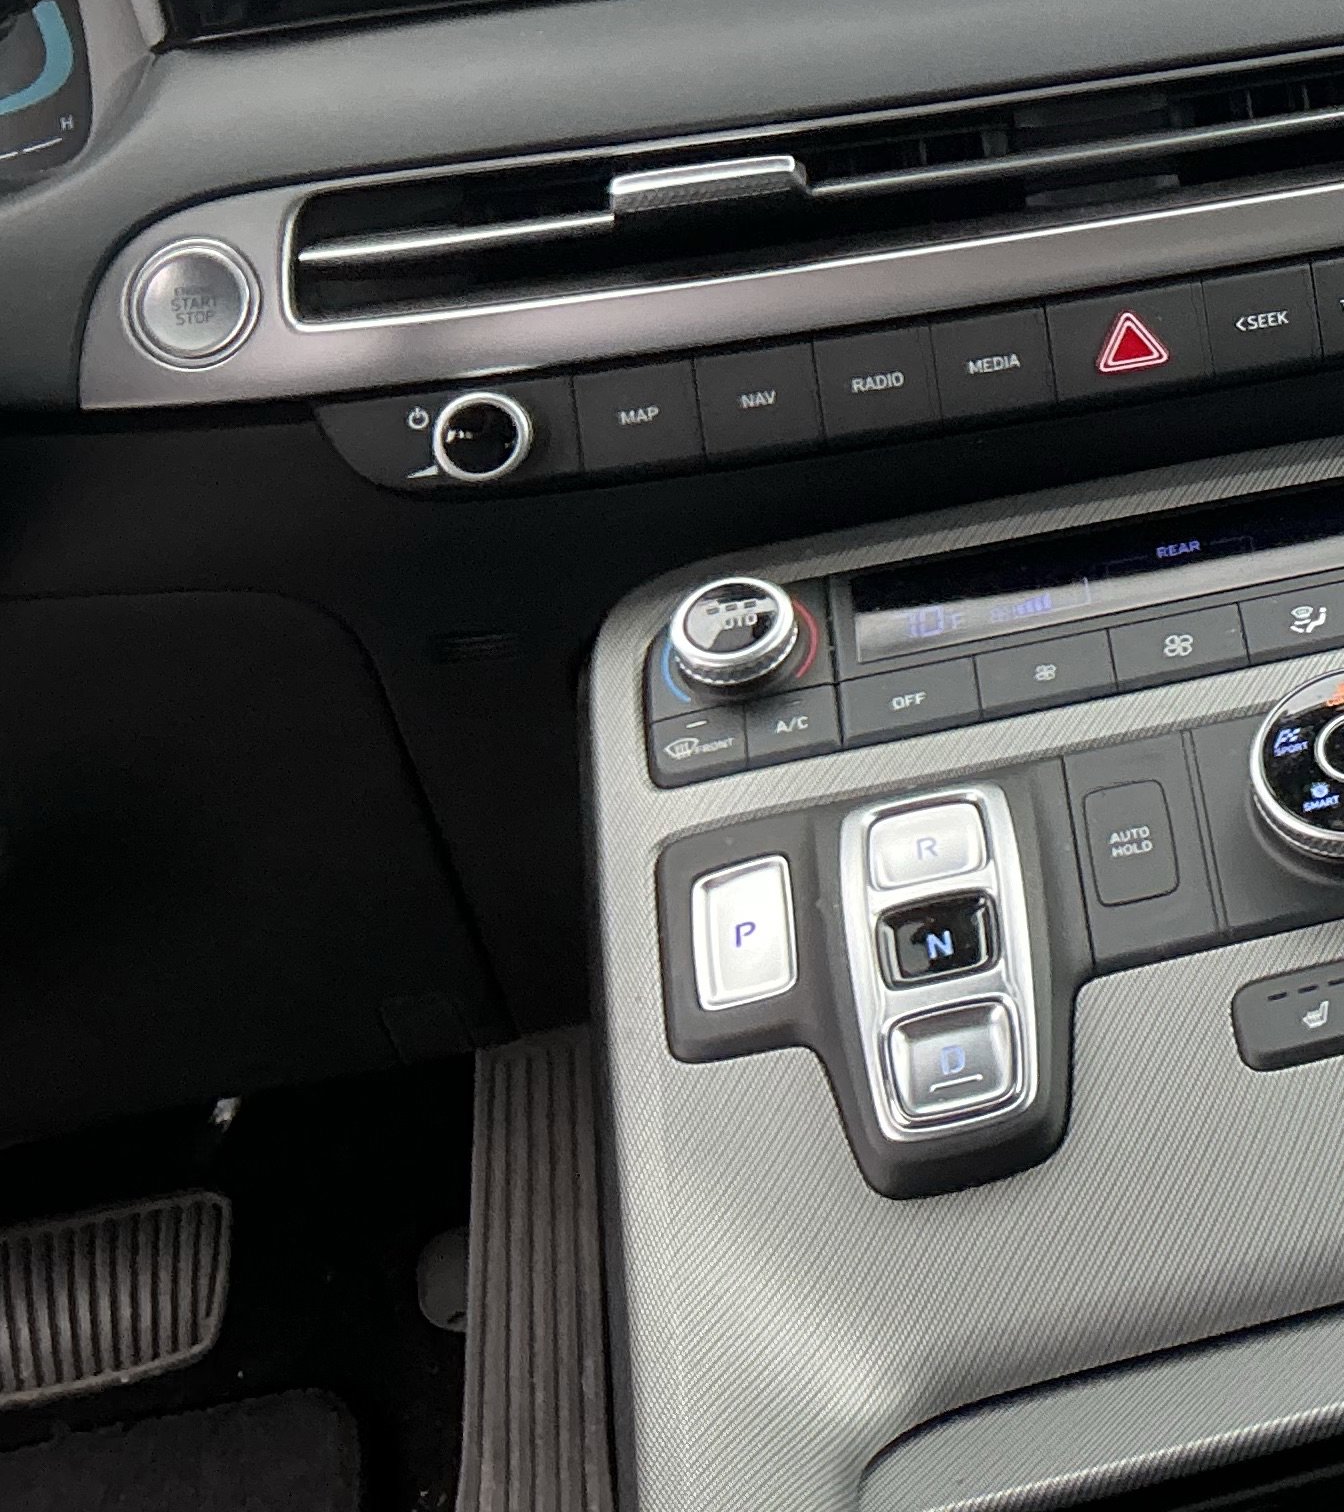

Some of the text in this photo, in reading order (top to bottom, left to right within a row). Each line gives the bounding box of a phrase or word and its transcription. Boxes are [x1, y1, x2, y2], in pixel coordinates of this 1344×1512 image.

[176, 310, 215, 326] STOP
[967, 352, 1020, 375] MEDIA
[851, 370, 904, 394] RADIO
[740, 390, 777, 409] NAV
[617, 405, 660, 426] MAP
[1155, 540, 1200, 559] REAR
[891, 692, 927, 711] OFF
[776, 716, 809, 734] A/C
[1273, 741, 1309, 758] SPORT
[1302, 794, 1340, 813] SMART
[1109, 824, 1151, 846] AUTO
[915, 836, 938, 861] R
[1111, 838, 1153, 859] HOLD
[734, 920, 757, 949] P
[925, 931, 955, 959] N
[940, 1045, 965, 1075] D
